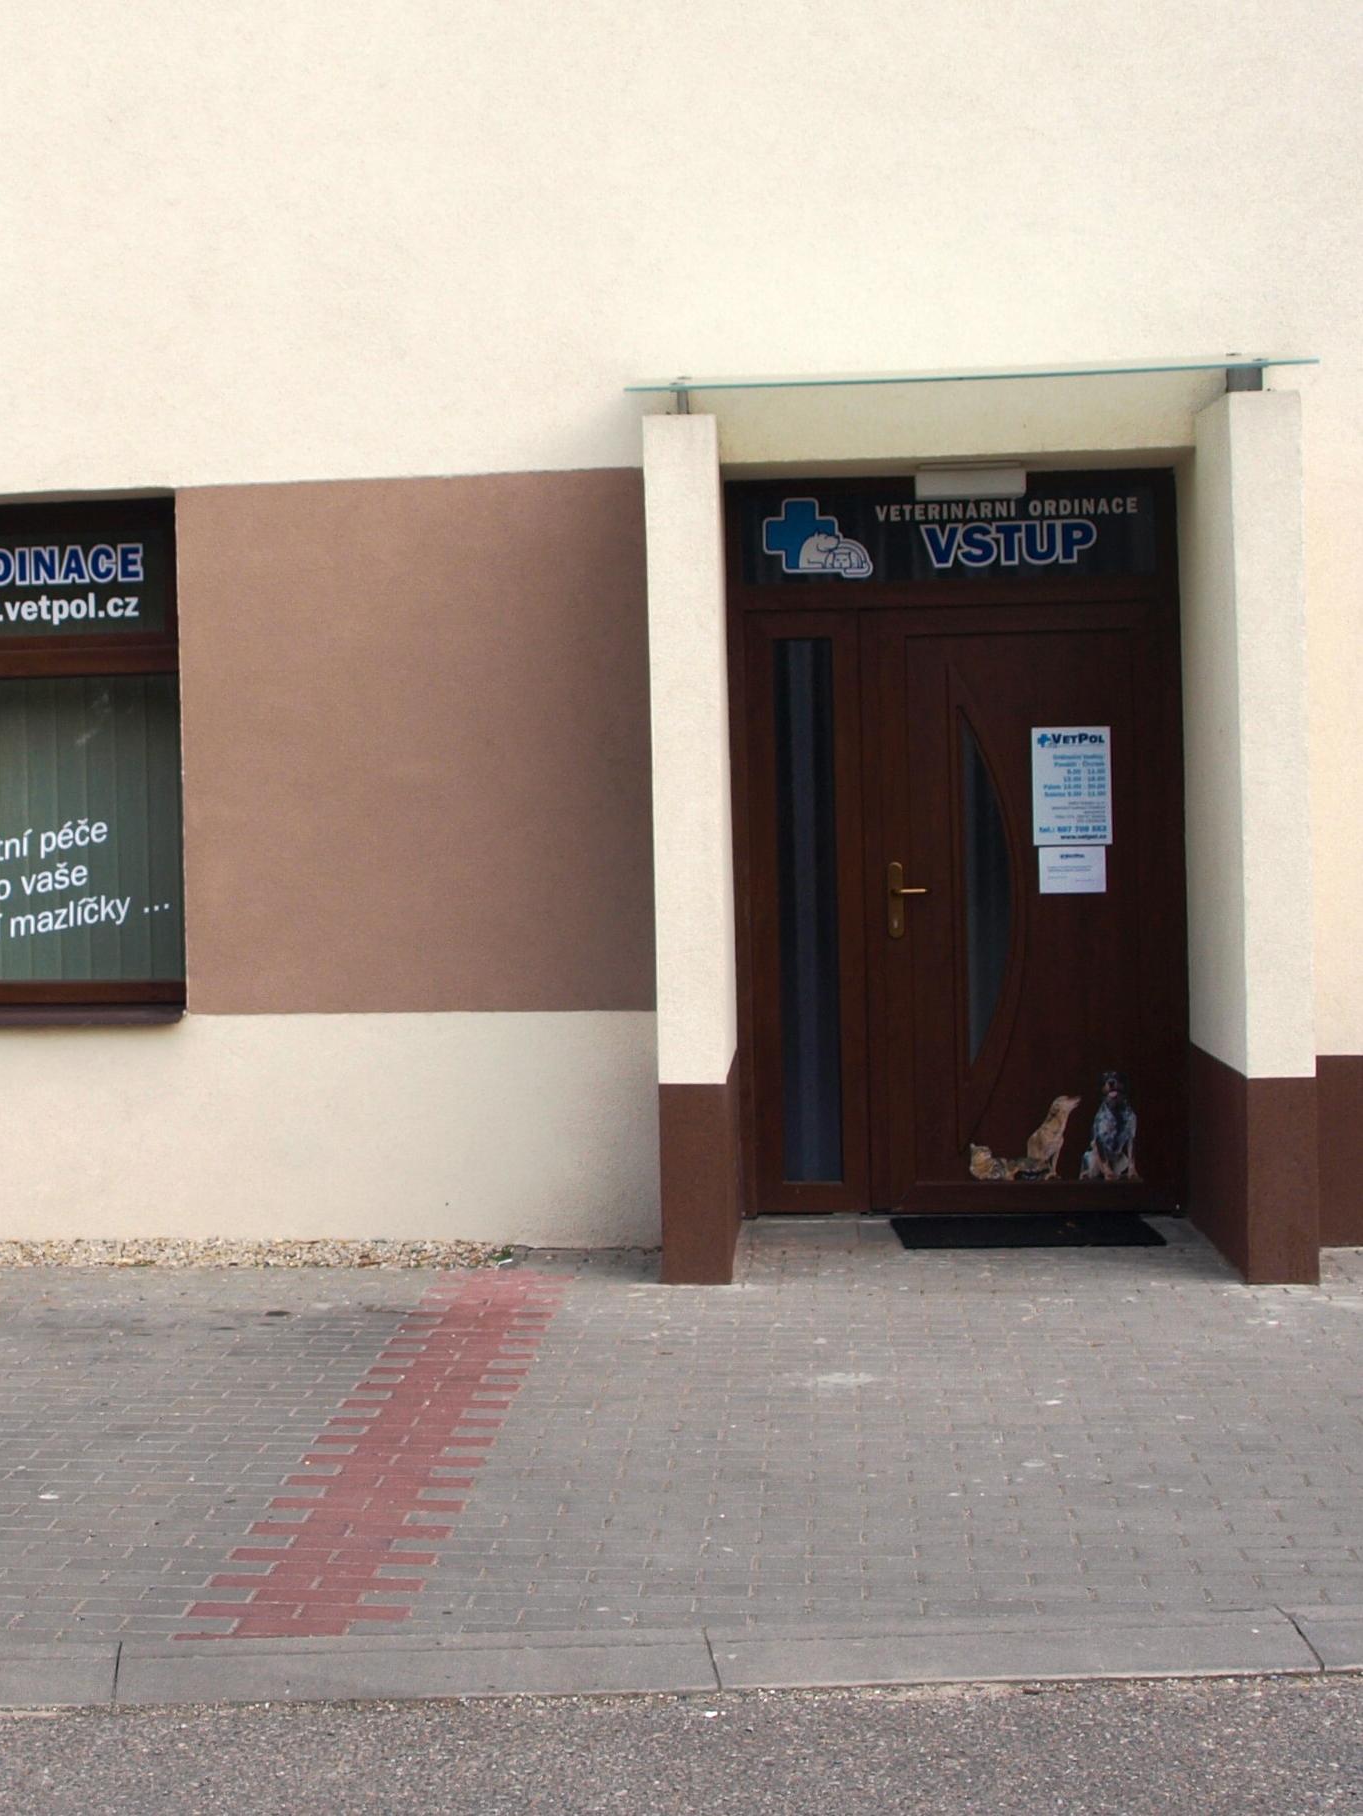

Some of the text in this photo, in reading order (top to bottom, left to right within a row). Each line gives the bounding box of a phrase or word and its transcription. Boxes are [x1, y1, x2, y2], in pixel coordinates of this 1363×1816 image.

[875, 496, 1139, 522] VETERINÁRNÍ ORDINACE
[921, 519, 1097, 568] VSTUP
[40, 818, 108, 859] péče
[21, 862, 89, 896] vaše
[10, 894, 131, 938] mazlíčky
